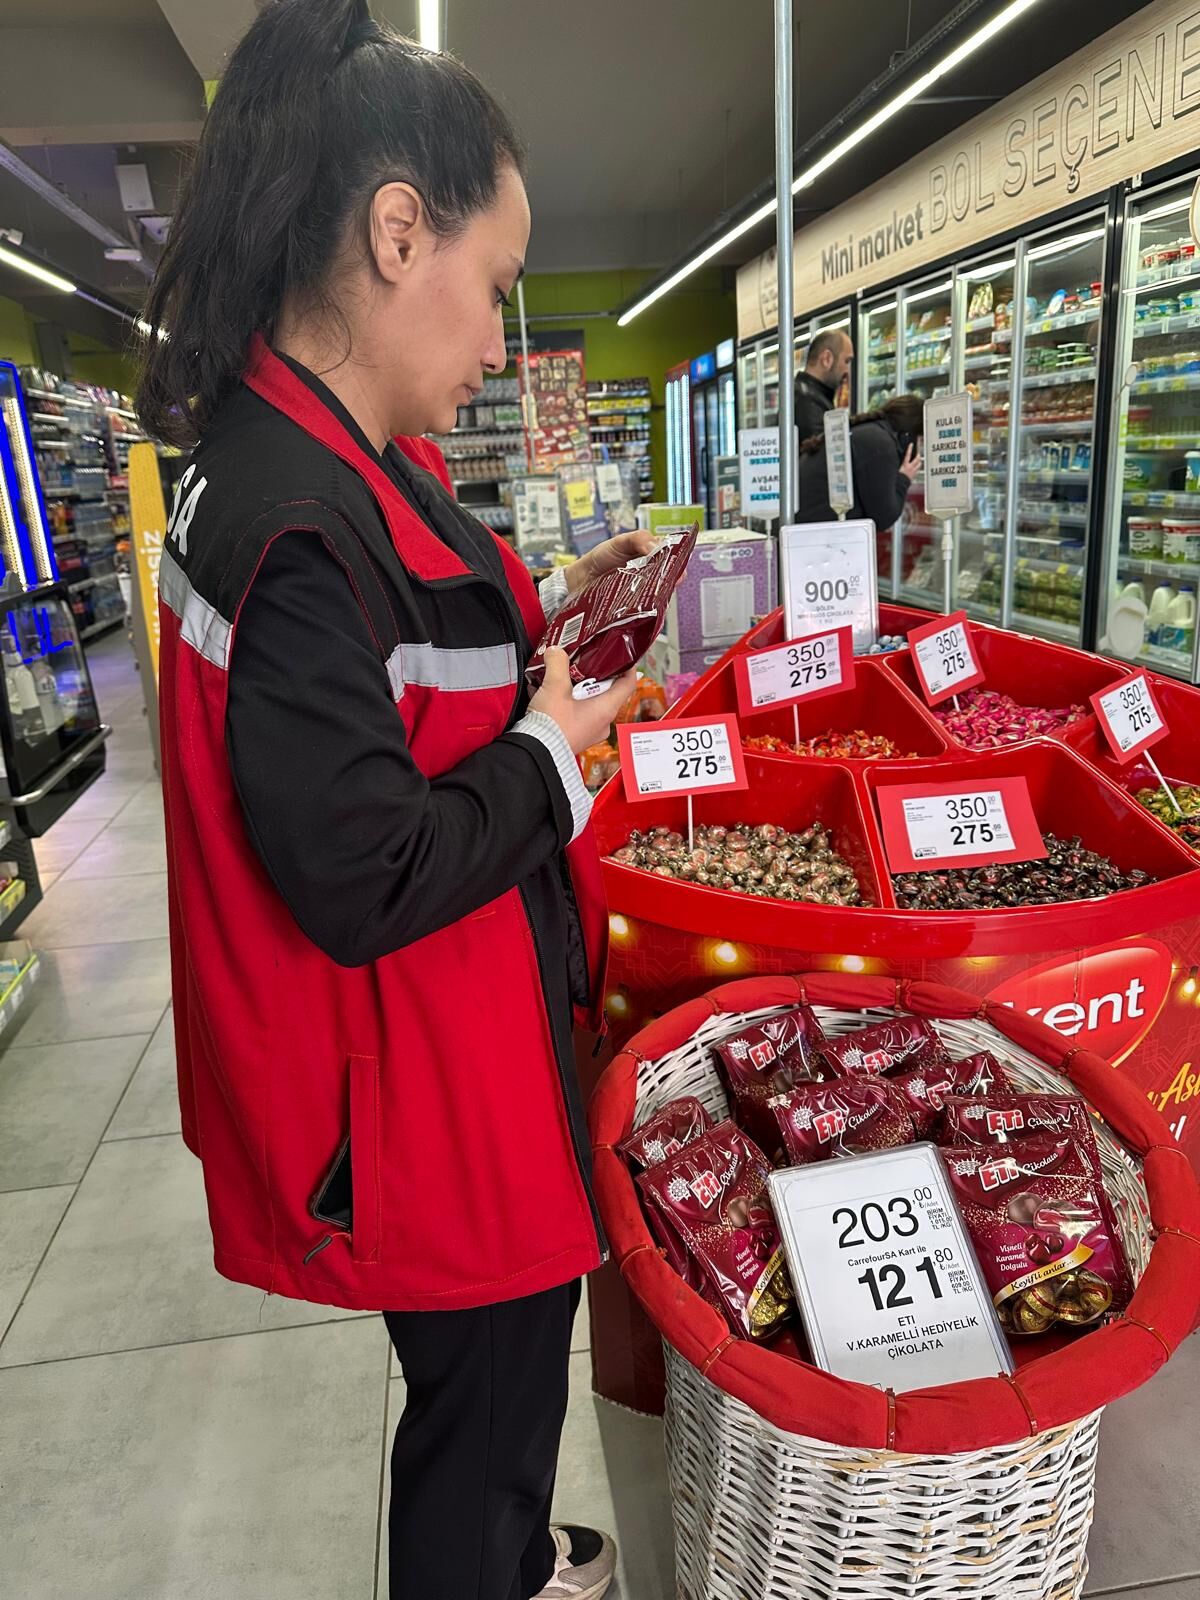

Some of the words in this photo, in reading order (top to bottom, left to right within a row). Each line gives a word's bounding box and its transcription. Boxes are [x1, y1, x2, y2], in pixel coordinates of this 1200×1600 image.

[821, 234, 854, 285] Mini
[859, 201, 923, 269] market
[929, 142, 995, 234] BOL
[743, 448, 771, 457] GAZOZ
[787, 641, 825, 665] 350
[936, 630, 958, 654] 350
[789, 663, 827, 688] 275
[943, 652, 965, 676] 275
[1120, 684, 1141, 709] 350
[1129, 706, 1151, 732] 275
[672, 729, 713, 753] 350
[676, 755, 718, 778] 275
[945, 797, 987, 820] 350
[950, 823, 993, 845] 275
[1002, 977, 1144, 1037] ent
[848, 1102, 879, 1130] Çikolata
[848, 1250, 896, 1268] CarrefourSA
[898, 1247, 916, 1258] Kart
[917, 1245, 927, 1255] ile
[999, 1243, 1023, 1253] Vişneli
[1001, 1262, 1028, 1271] Dolgulu
[1011, 1273, 1042, 1291] Keyifli
[897, 1315, 915, 1327] ETI
[847, 1328, 920, 1351] V.KARAMELLİ
[921, 1316, 979, 1338] HEDİYELİK
[887, 1338, 943, 1360] ÇİKOLATA
